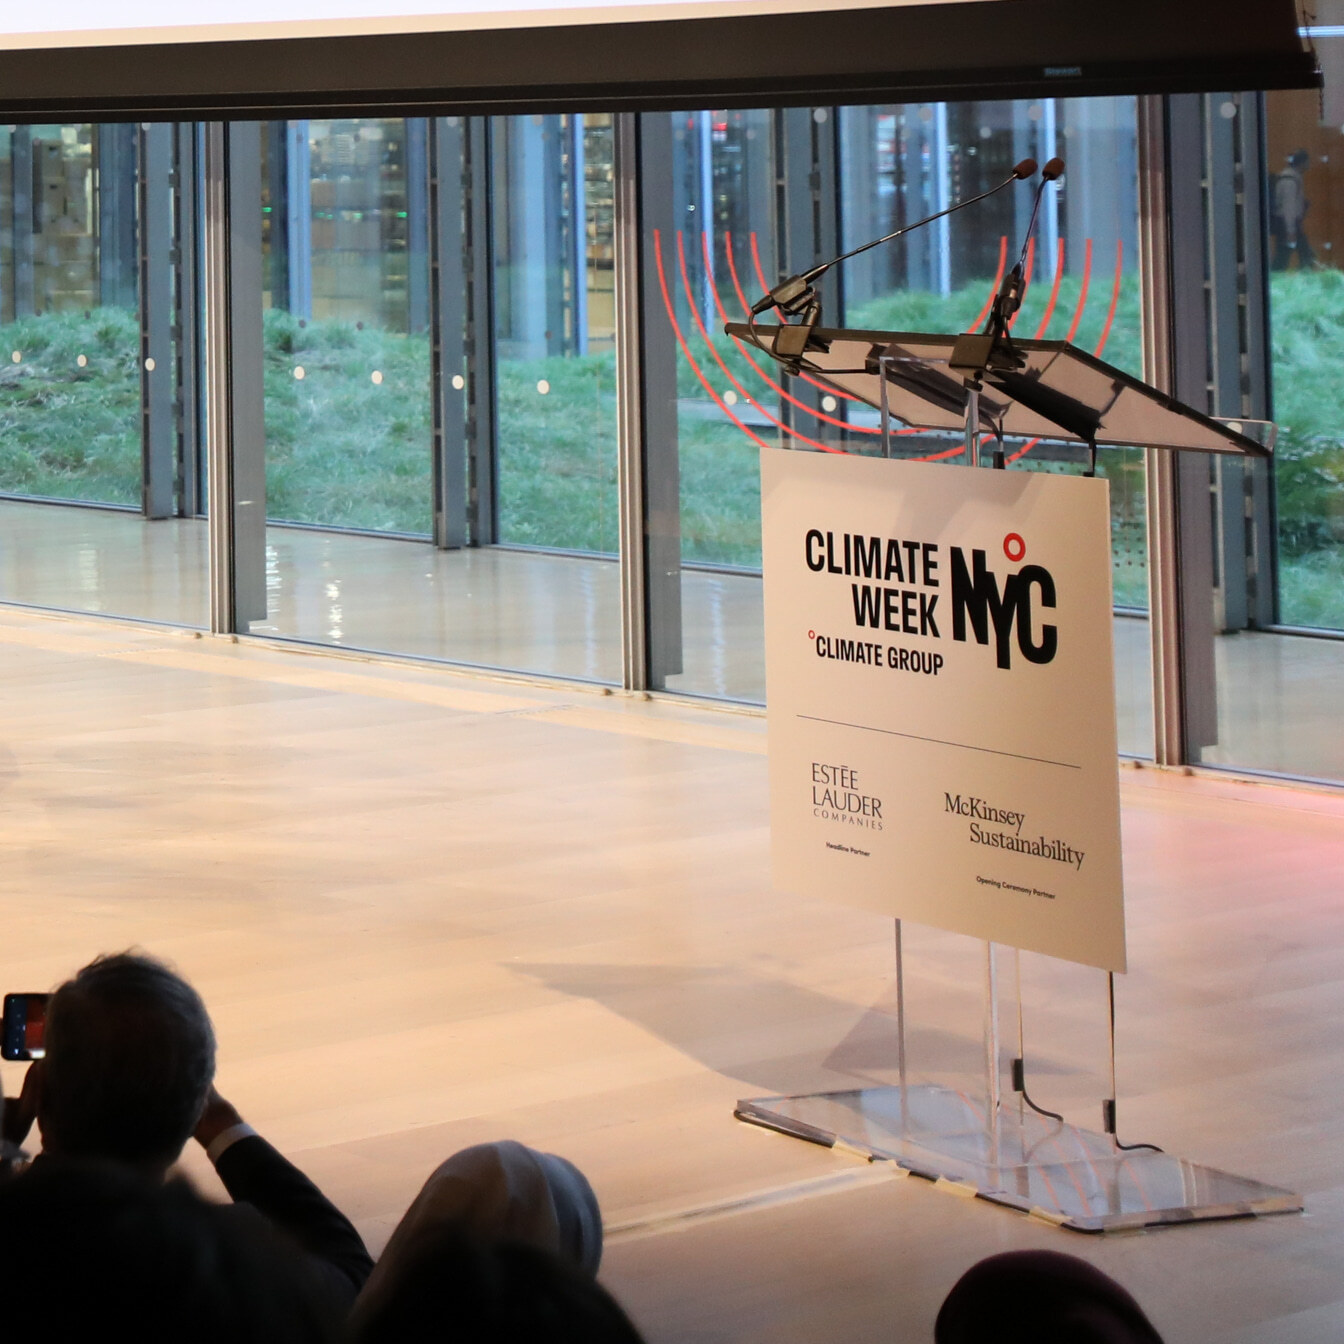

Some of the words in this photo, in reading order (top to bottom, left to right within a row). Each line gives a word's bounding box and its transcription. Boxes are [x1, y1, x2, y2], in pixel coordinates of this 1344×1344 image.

[805, 528, 940, 587] CLIMATE
[851, 583, 941, 638] WEEK
[949, 545, 1058, 670] NYC
[887, 646, 944, 676] GROUP
[812, 785, 883, 819] LAUDER
[813, 808, 883, 831] COMPANIES
[944, 792, 1025, 833] McKinsey
[850, 846, 871, 857] Partner
[969, 822, 1085, 871] Sustainability
[975, 875, 1001, 889] Opening
[1002, 881, 1032, 896] Ceremony
[1033, 888, 1056, 900] Partner
